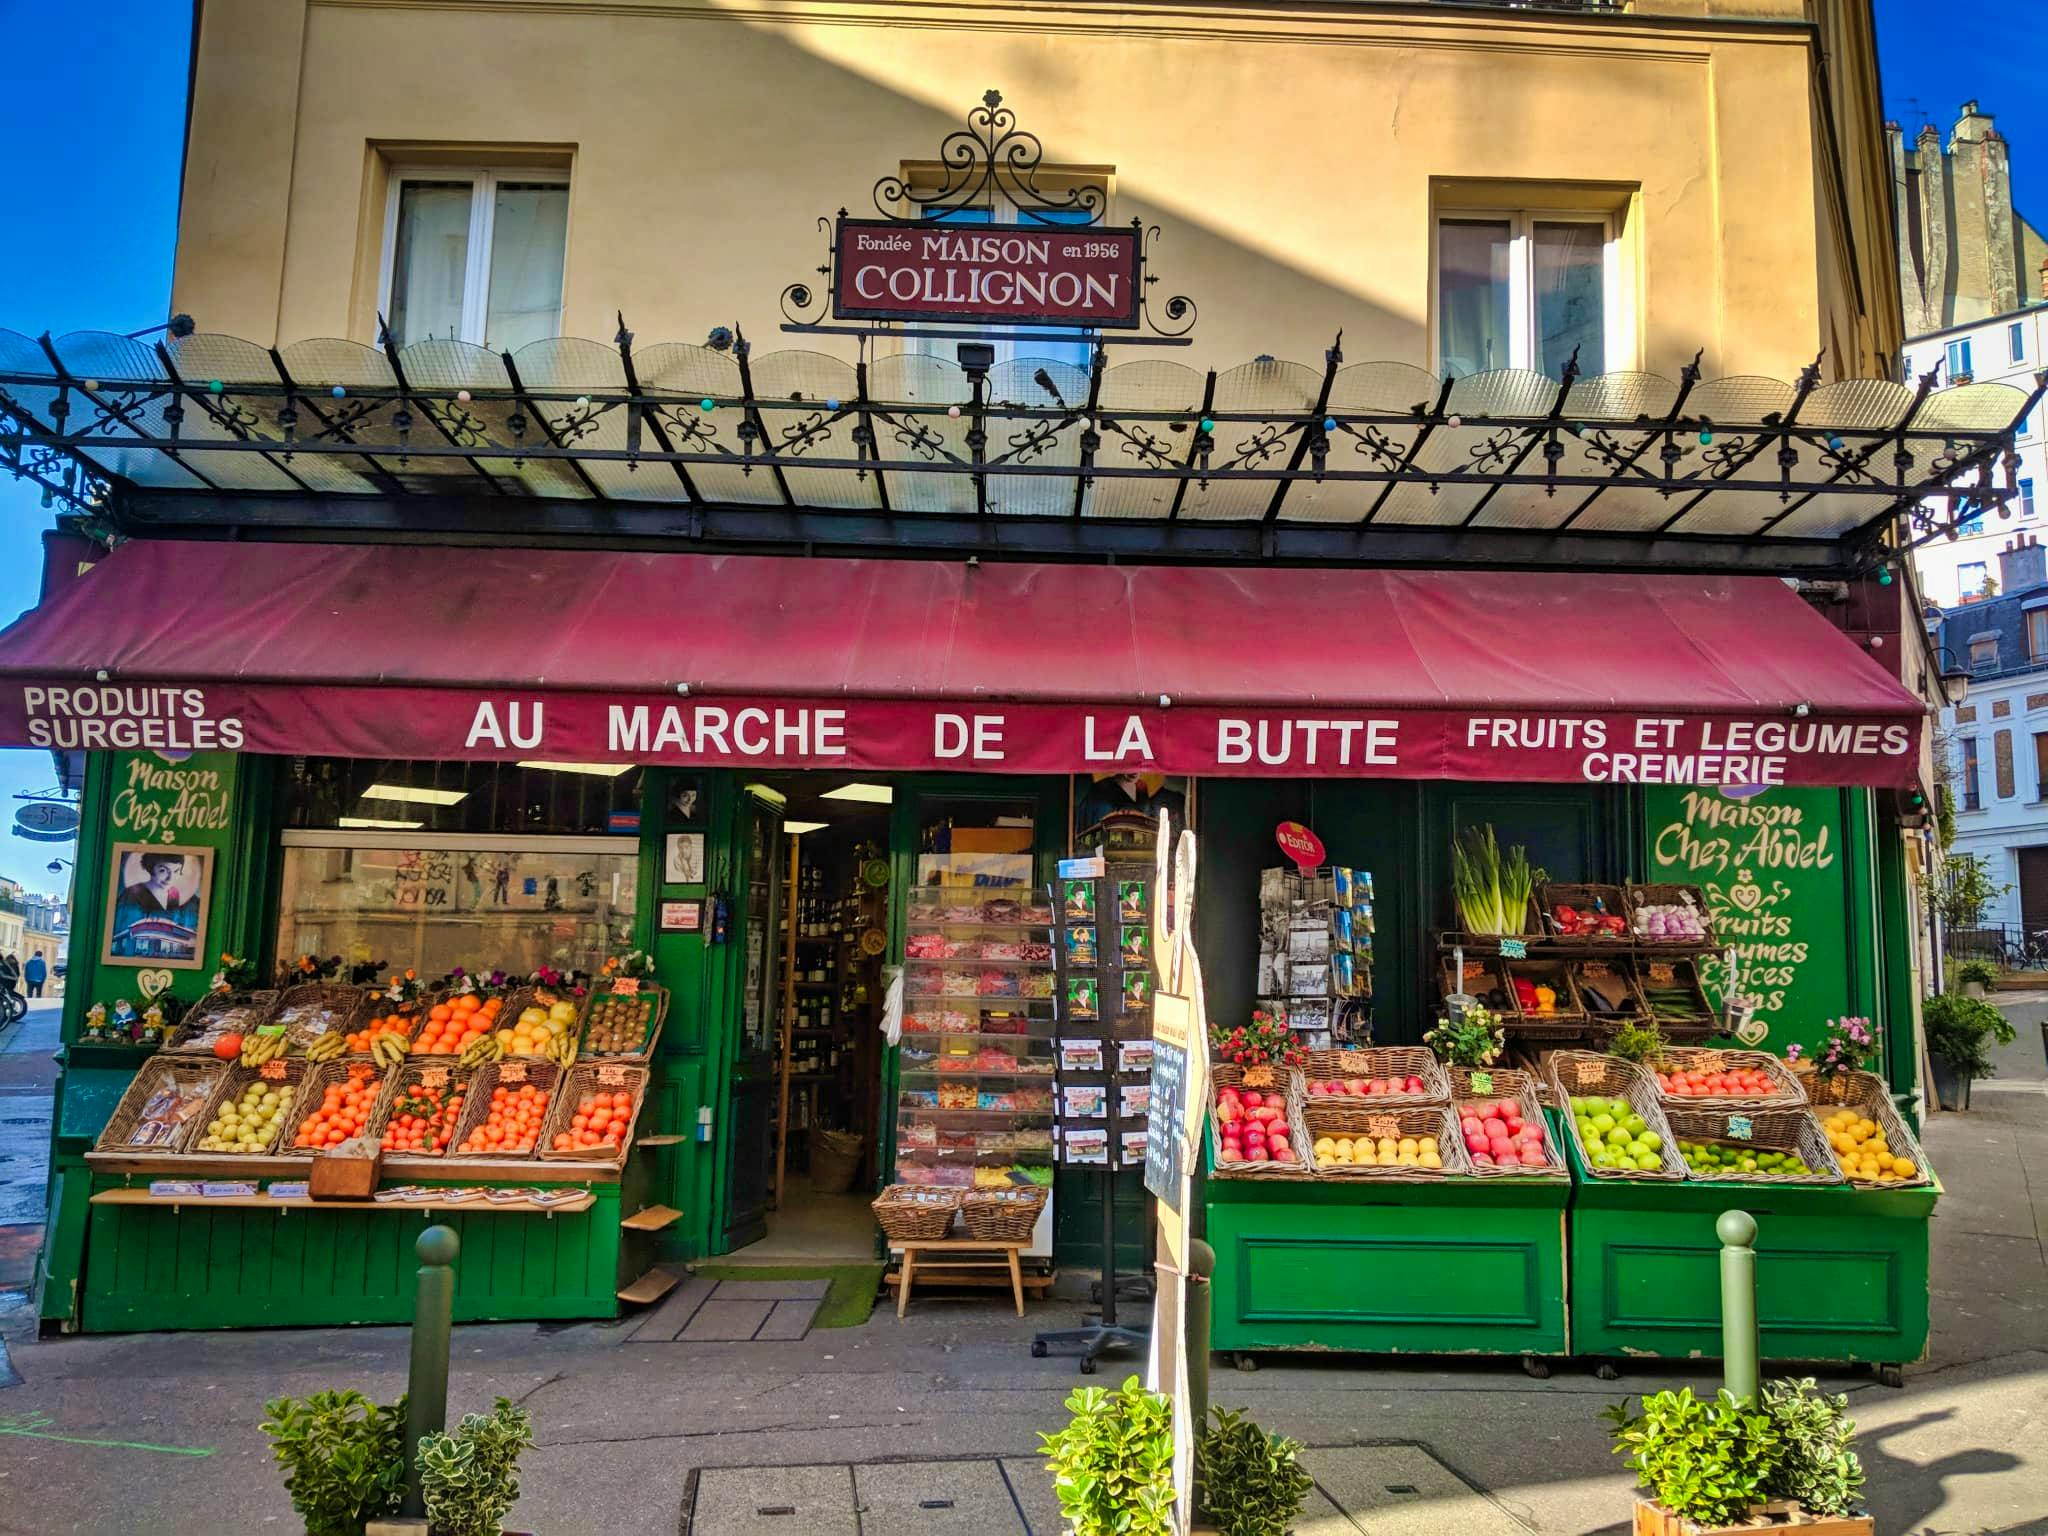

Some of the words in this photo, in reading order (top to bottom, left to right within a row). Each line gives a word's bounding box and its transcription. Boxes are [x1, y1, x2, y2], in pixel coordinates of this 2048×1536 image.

[857, 234, 912, 251] Fondée
[921, 237, 1050, 265] MAISON
[1063, 246, 1082, 258] en
[1083, 243, 1119, 259] 1956
[855, 265, 1119, 308] COLLIGNON
[24, 687, 205, 718] PRODUITS
[28, 718, 244, 749] SURGELES
[465, 701, 544, 749] AU
[608, 705, 847, 755] MARCHE
[934, 714, 1005, 760] DE
[1084, 715, 1154, 760] LA
[1217, 719, 1400, 765] BUTTE
[1467, 718, 1607, 749] FRUITS
[1634, 719, 1682, 750] ET
[1700, 721, 1909, 755] LEGUMES
[126, 758, 221, 790] Maison
[1582, 752, 1787, 785] CREMERIE
[112, 788, 162, 838] Chez
[1680, 791, 1804, 829] Maison
[1655, 822, 1731, 876] Chez
[1733, 824, 1834, 869] Abdel
